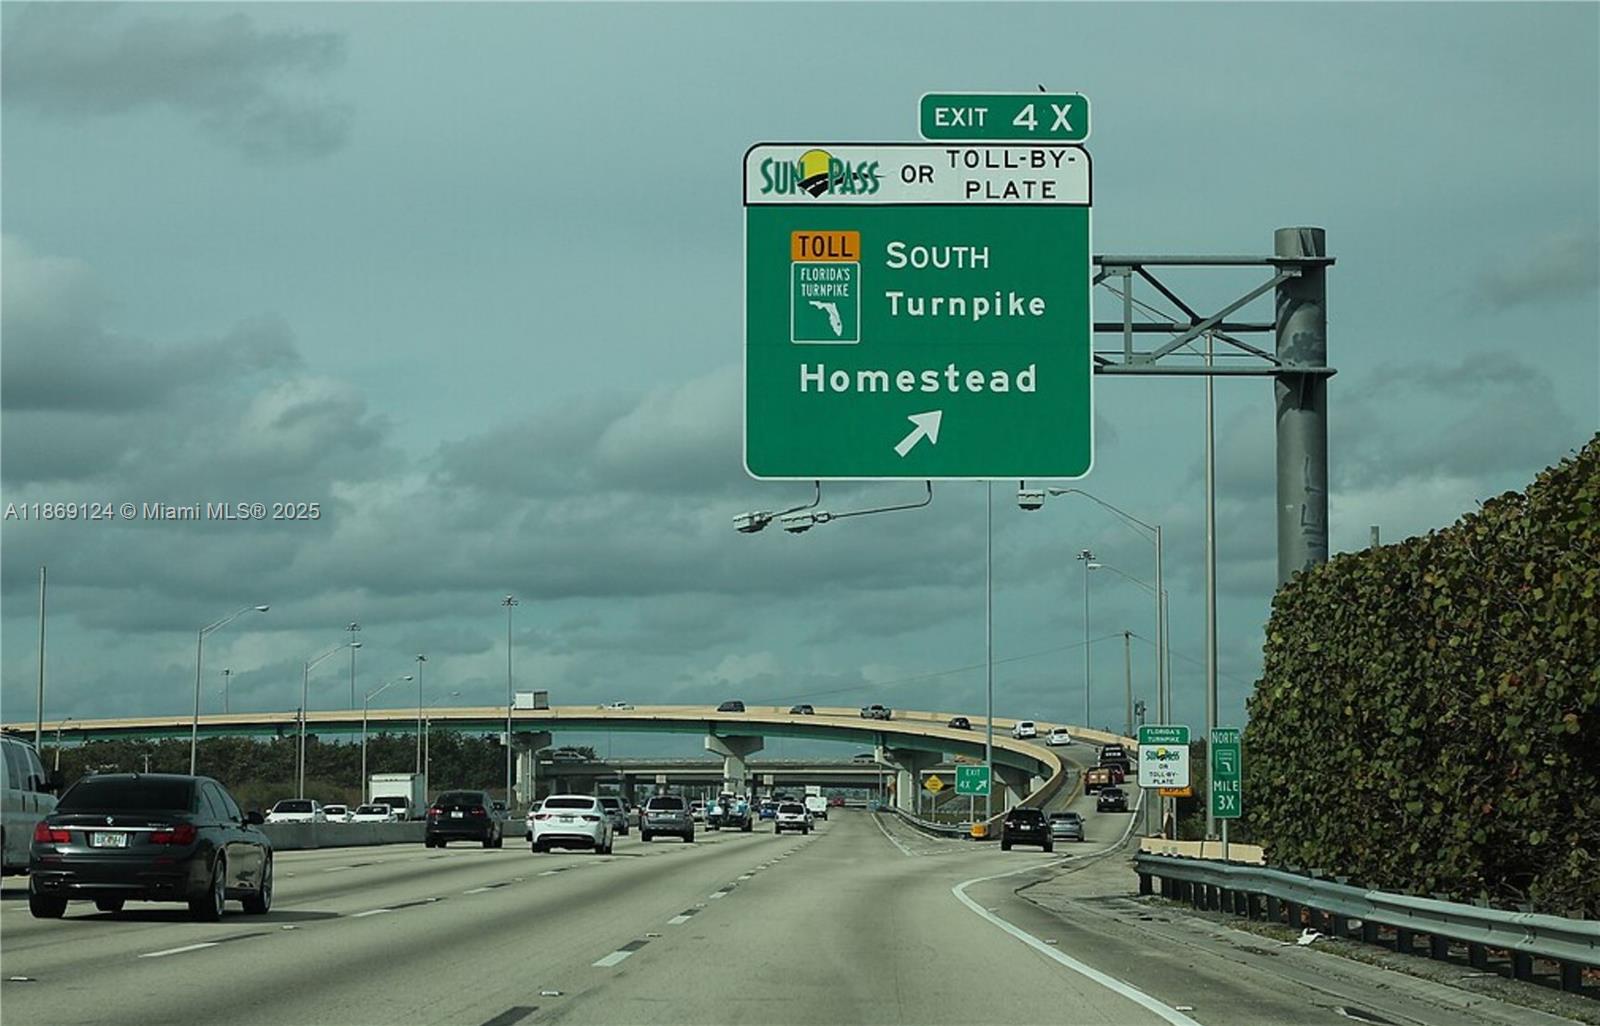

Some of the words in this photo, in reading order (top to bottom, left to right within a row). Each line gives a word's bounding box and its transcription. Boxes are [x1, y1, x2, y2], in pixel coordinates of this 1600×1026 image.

[935, 107, 988, 127] EXIT
[946, 150, 1076, 168] TOLL-BY-
[901, 165, 934, 183] OR
[965, 181, 1057, 199] PLATE
[798, 236, 853, 258] TOLL
[885, 242, 989, 269] SOUTH
[800, 268, 851, 281] FLORIDA'S
[801, 283, 849, 297] TURNPIKE
[885, 291, 1046, 321] Turnpike
[800, 363, 1037, 393] Homestead
[1211, 731, 1240, 744] NORTH
[965, 768, 981, 777] EXIT
[959, 780, 971, 789] 4X
[1213, 780, 1240, 792] MILE
[1217, 795, 1235, 810] 3X
